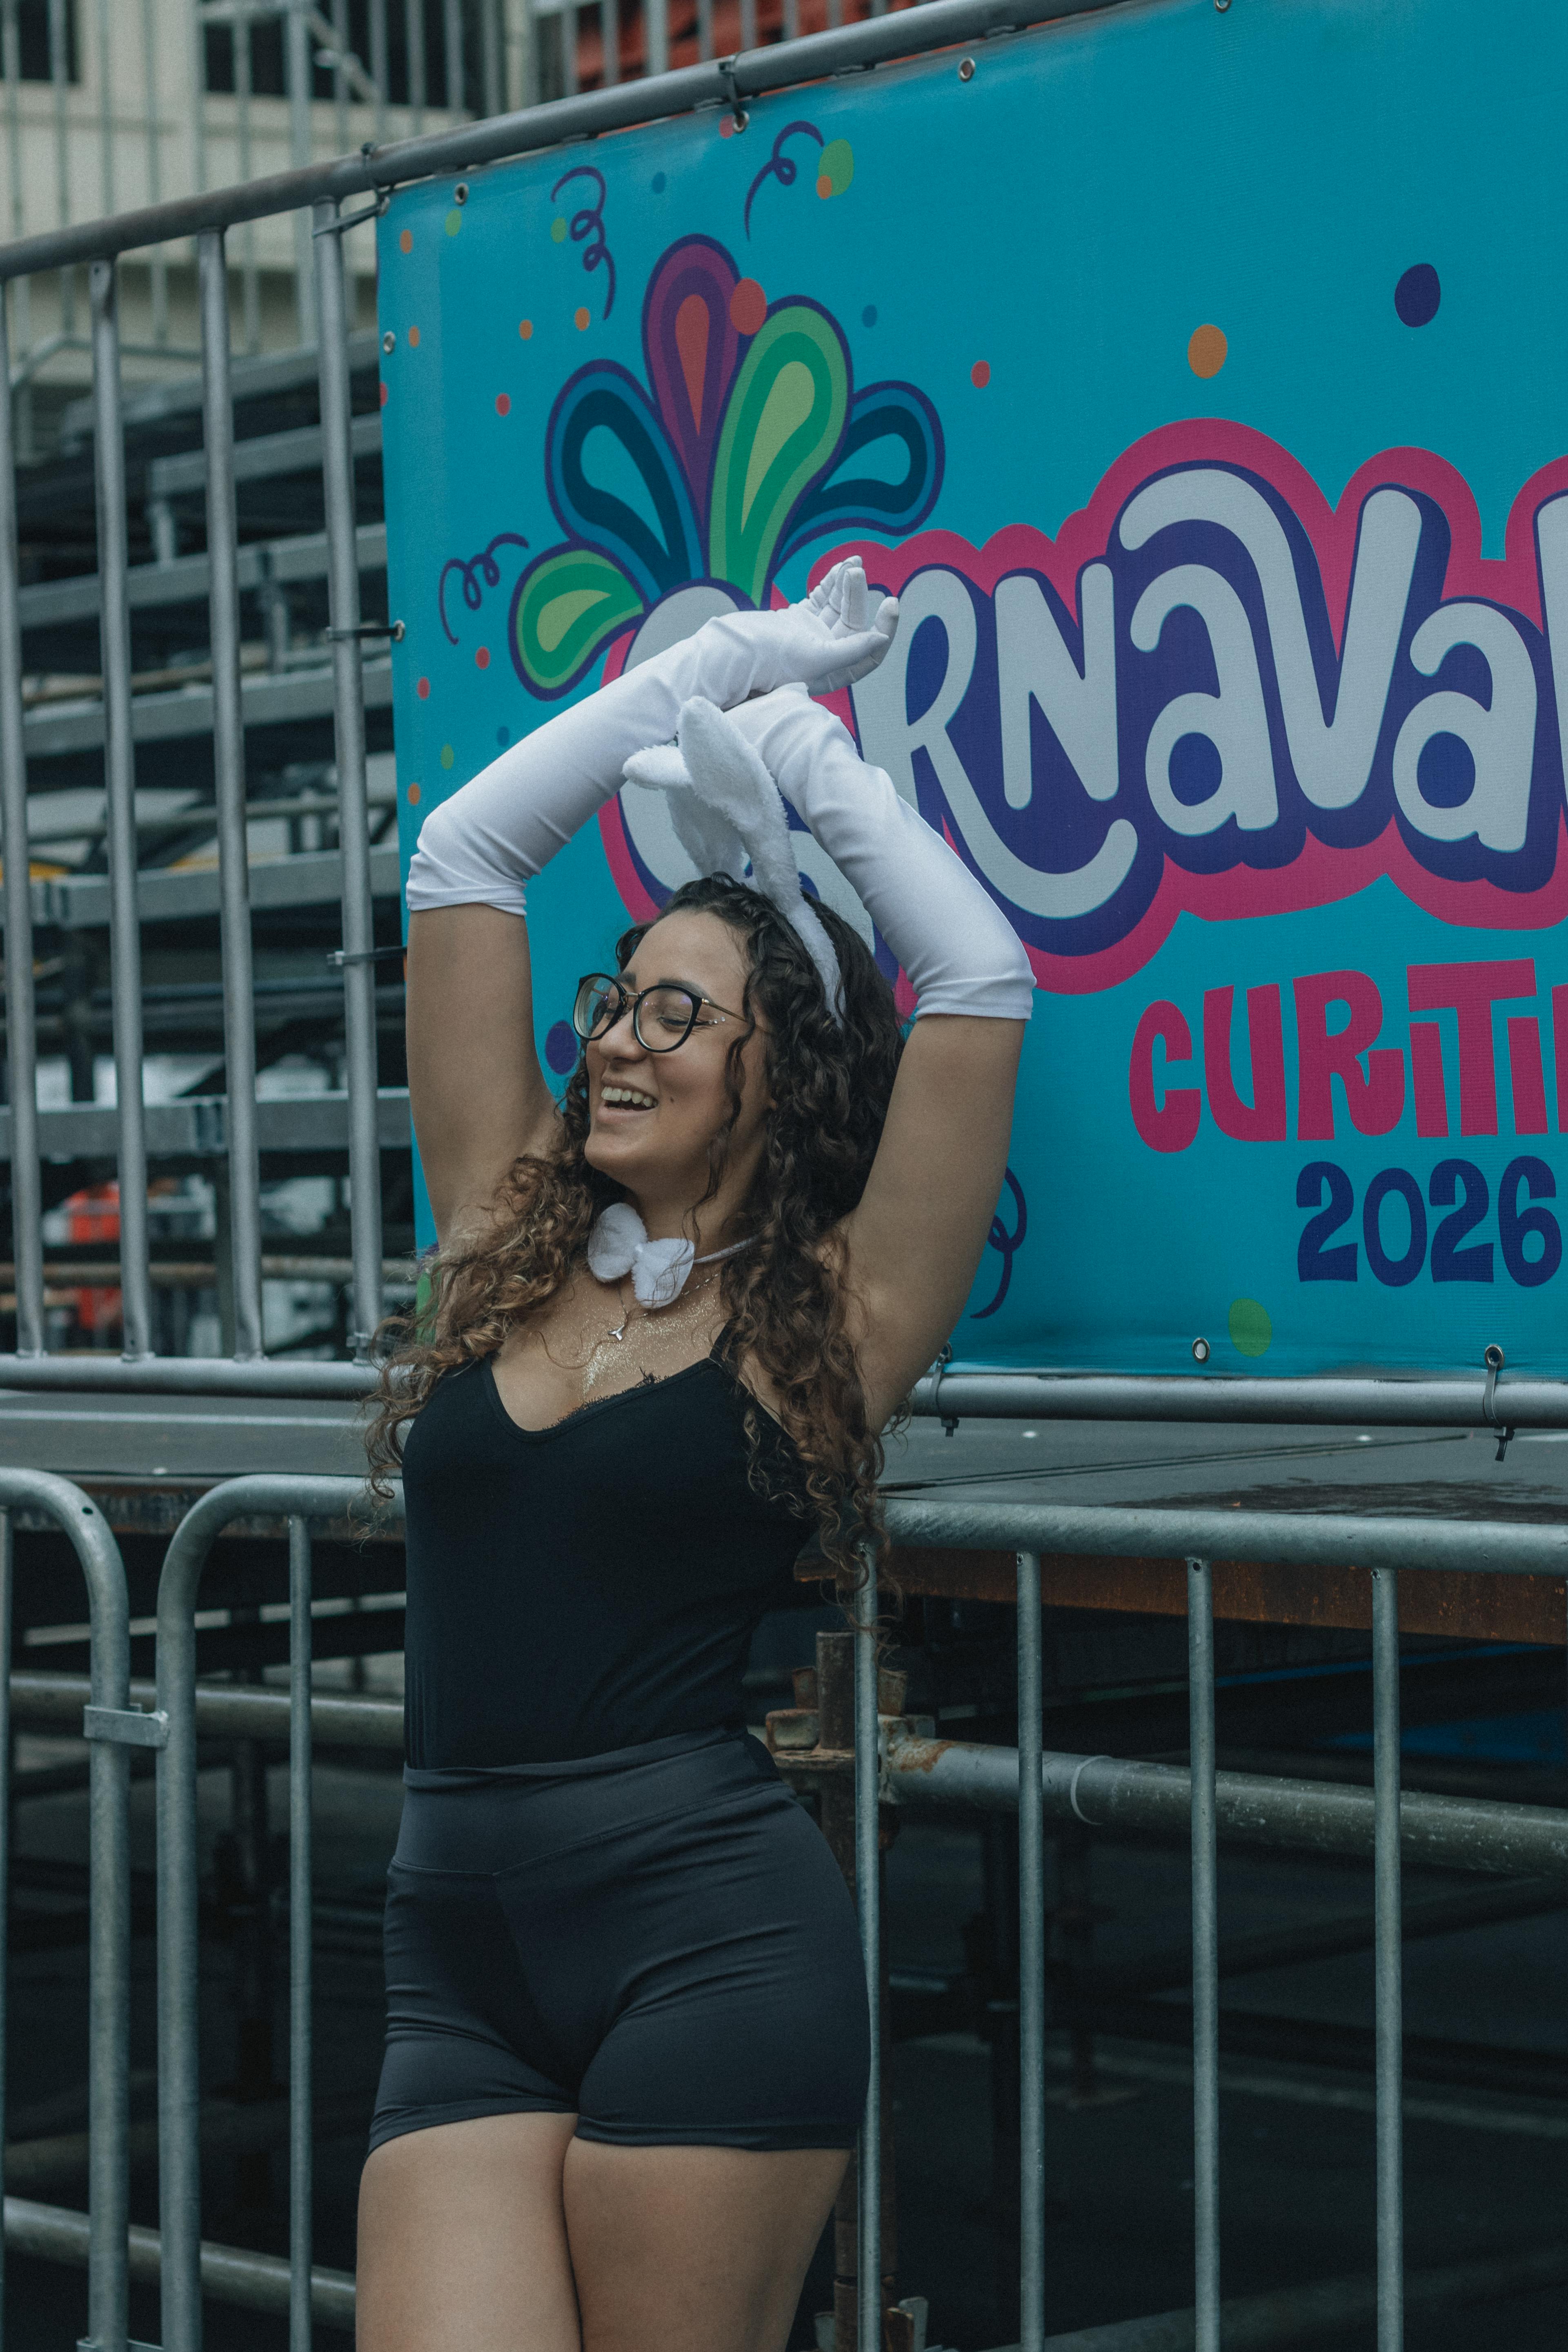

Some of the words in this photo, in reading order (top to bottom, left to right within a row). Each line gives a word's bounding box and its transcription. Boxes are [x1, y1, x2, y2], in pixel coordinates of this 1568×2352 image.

[618, 468, 1568, 953] RNaVa
[1128, 957, 1568, 1154] CURITI
[1296, 1155, 1563, 1287] 2026
